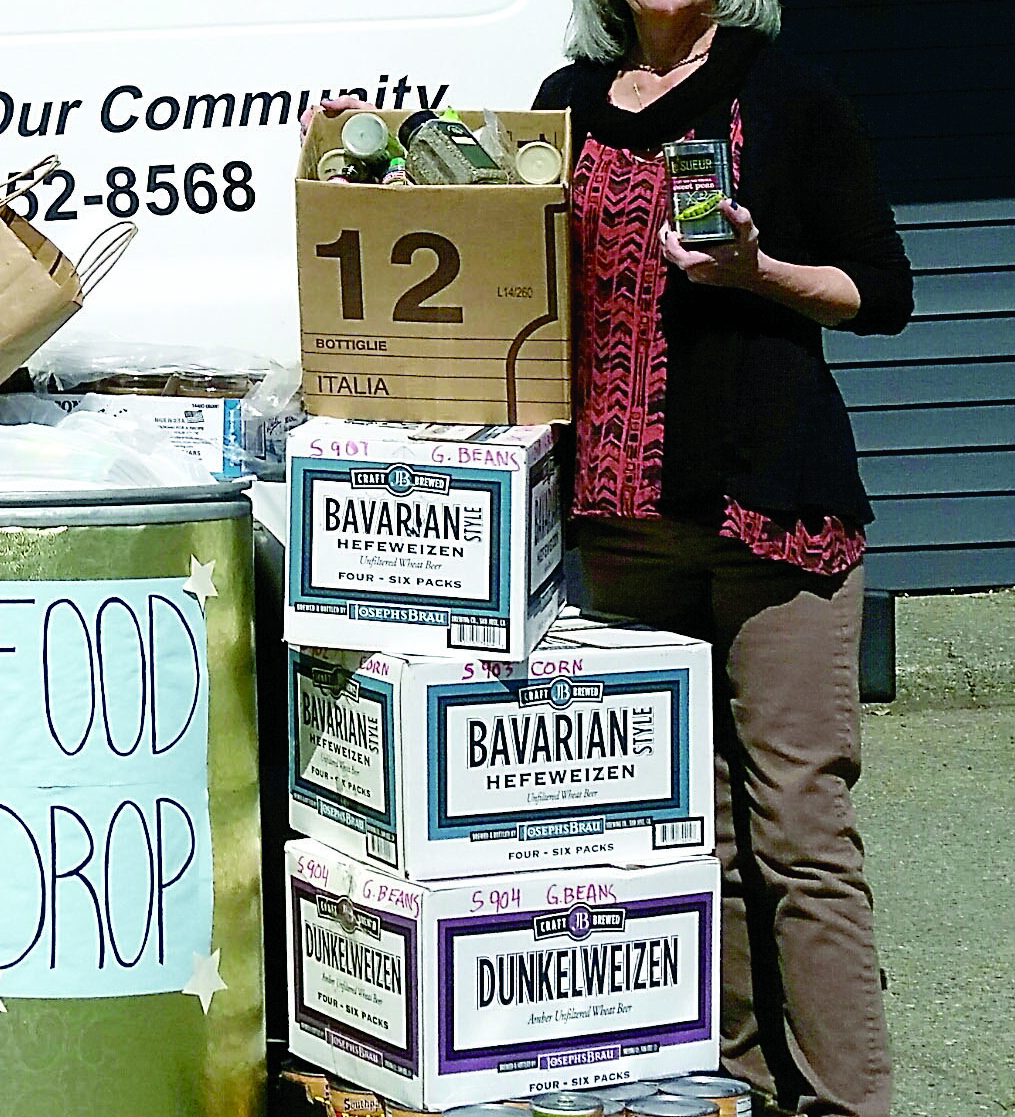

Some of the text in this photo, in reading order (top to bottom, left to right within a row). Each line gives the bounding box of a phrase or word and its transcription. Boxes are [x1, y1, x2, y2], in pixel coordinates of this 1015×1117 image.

[316, 229, 464, 324] 12
[497, 285, 534, 299] L14/260
[315, 338, 388, 352] BOTTIGLIE
[317, 375, 390, 396] ITALIA
[357, 472, 446, 490] CRAFT BREWED
[324, 496, 482, 543] BAVARIAN STYLE
[337, 538, 464, 558] HEFEWEIZEN
[359, 555, 442, 570] Unfiltered Wheat Beer
[338, 571, 463, 589] FOUR SIX PACKS
[531, 657, 584, 677] CORN
[572, 685, 601, 700] BREWED
[302, 691, 380, 755] BAVARIAN STYLE
[467, 704, 655, 770] BAVARIAN STYLE
[310, 733, 371, 768] HEFEWEIZEN
[311, 765, 372, 798] FOUR PACKS
[485, 763, 636, 791] HEFEWEIZEN
[527, 788, 599, 806] Unfiltered Wheat Beer
[508, 843, 615, 861] FOUR SIX PACKS
[539, 912, 623, 935] CRAFT BREWED
[305, 921, 403, 996] DUNKELWEIZEN
[476, 934, 680, 1011] DUNKELWEIZEN
[317, 991, 390, 1030] FOUR SIX PACKS
[528, 1002, 633, 1026] Amber Unfiltered Wheat Beer
[529, 1070, 632, 1093] FOUR SIX PACKS
